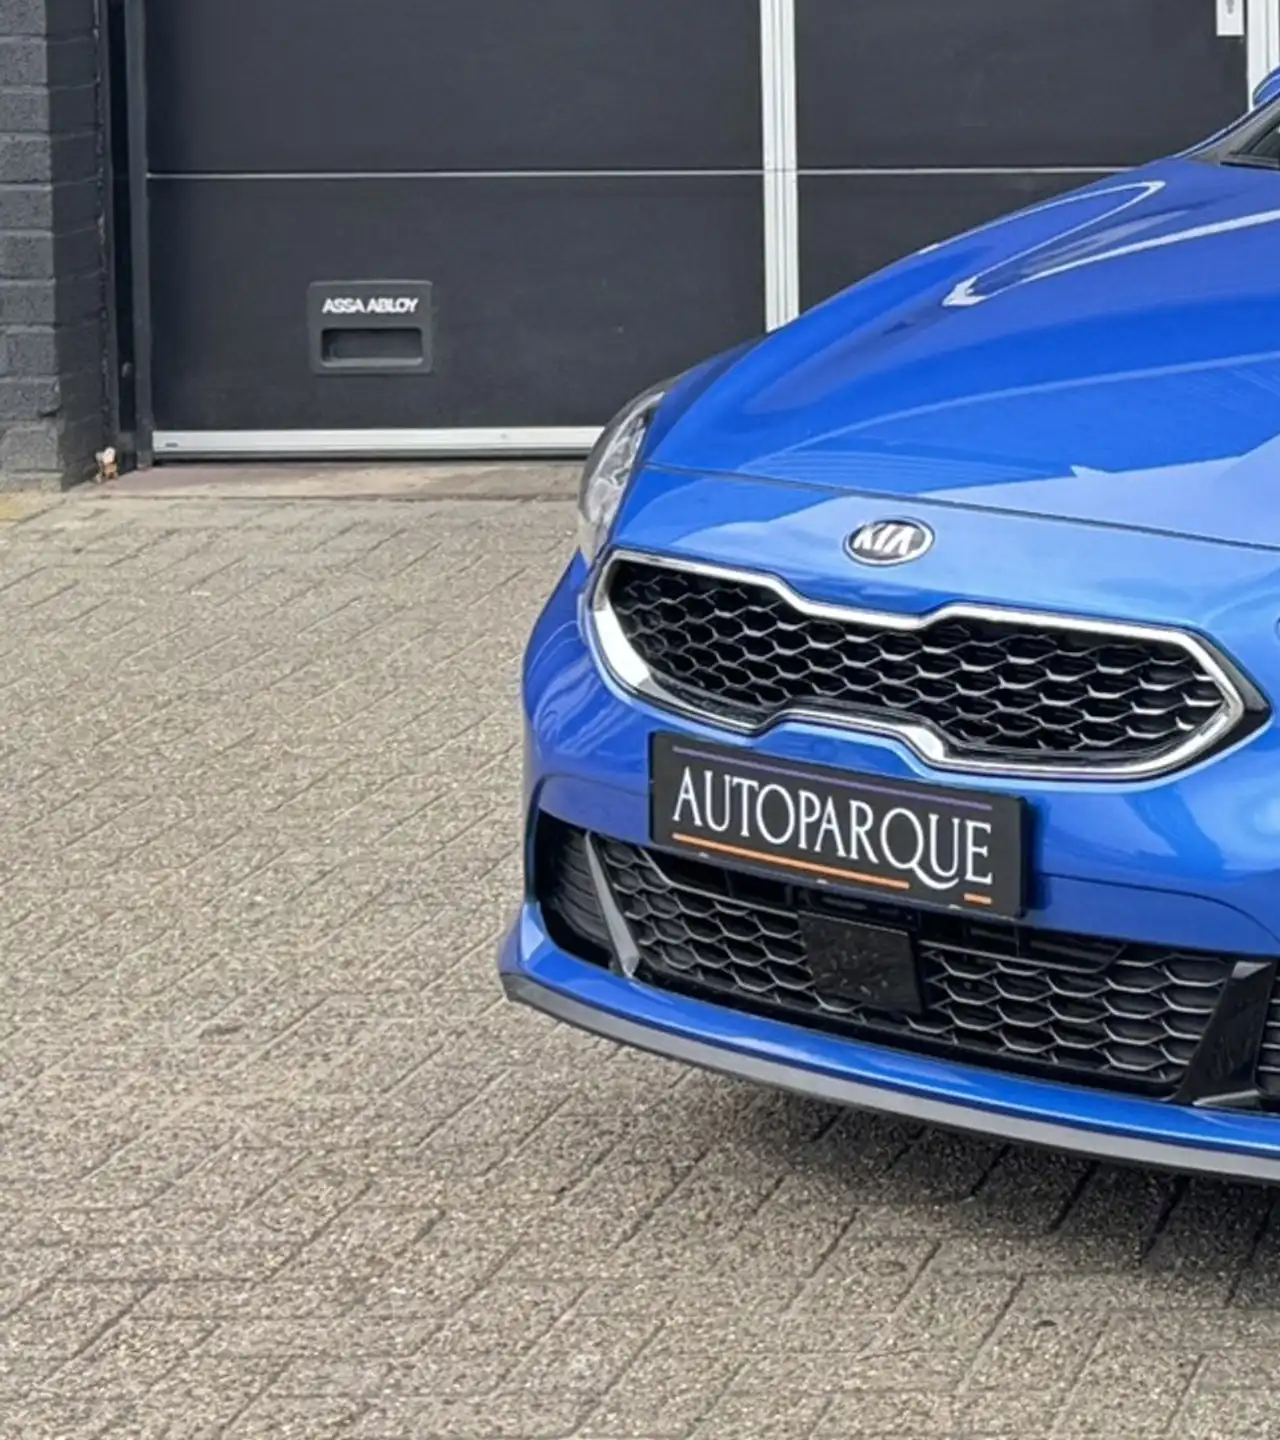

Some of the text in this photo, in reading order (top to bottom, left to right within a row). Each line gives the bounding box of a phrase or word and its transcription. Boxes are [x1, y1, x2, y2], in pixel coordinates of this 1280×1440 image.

[321, 297, 419, 314] ASSA ABLOY
[852, 522, 917, 557] KIA
[672, 765, 993, 891] AUTOPARQUE
